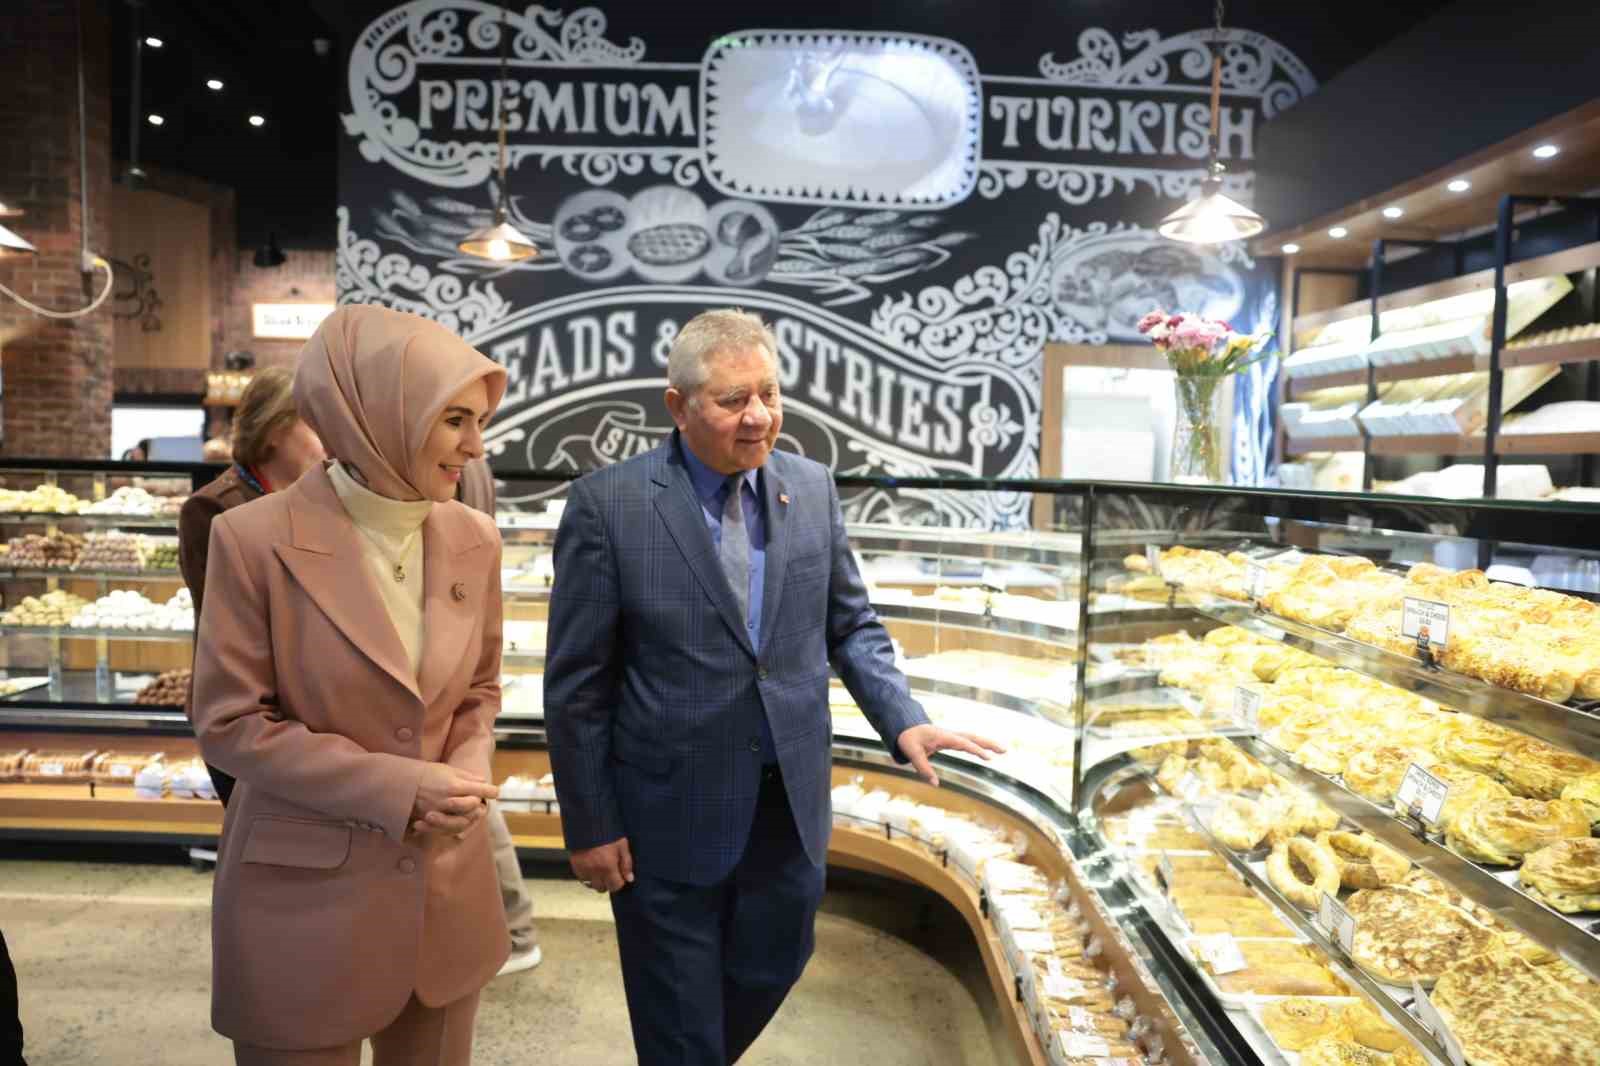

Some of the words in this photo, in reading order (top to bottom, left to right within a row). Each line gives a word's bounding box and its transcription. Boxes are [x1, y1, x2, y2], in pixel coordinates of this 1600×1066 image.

[418, 80, 696, 136] PREMIUM
[990, 96, 1254, 159] TURKISH
[492, 311, 636, 409] EADS
[652, 319, 678, 365] &
[776, 319, 964, 454] STRIES
[600, 427, 659, 460] SIN
